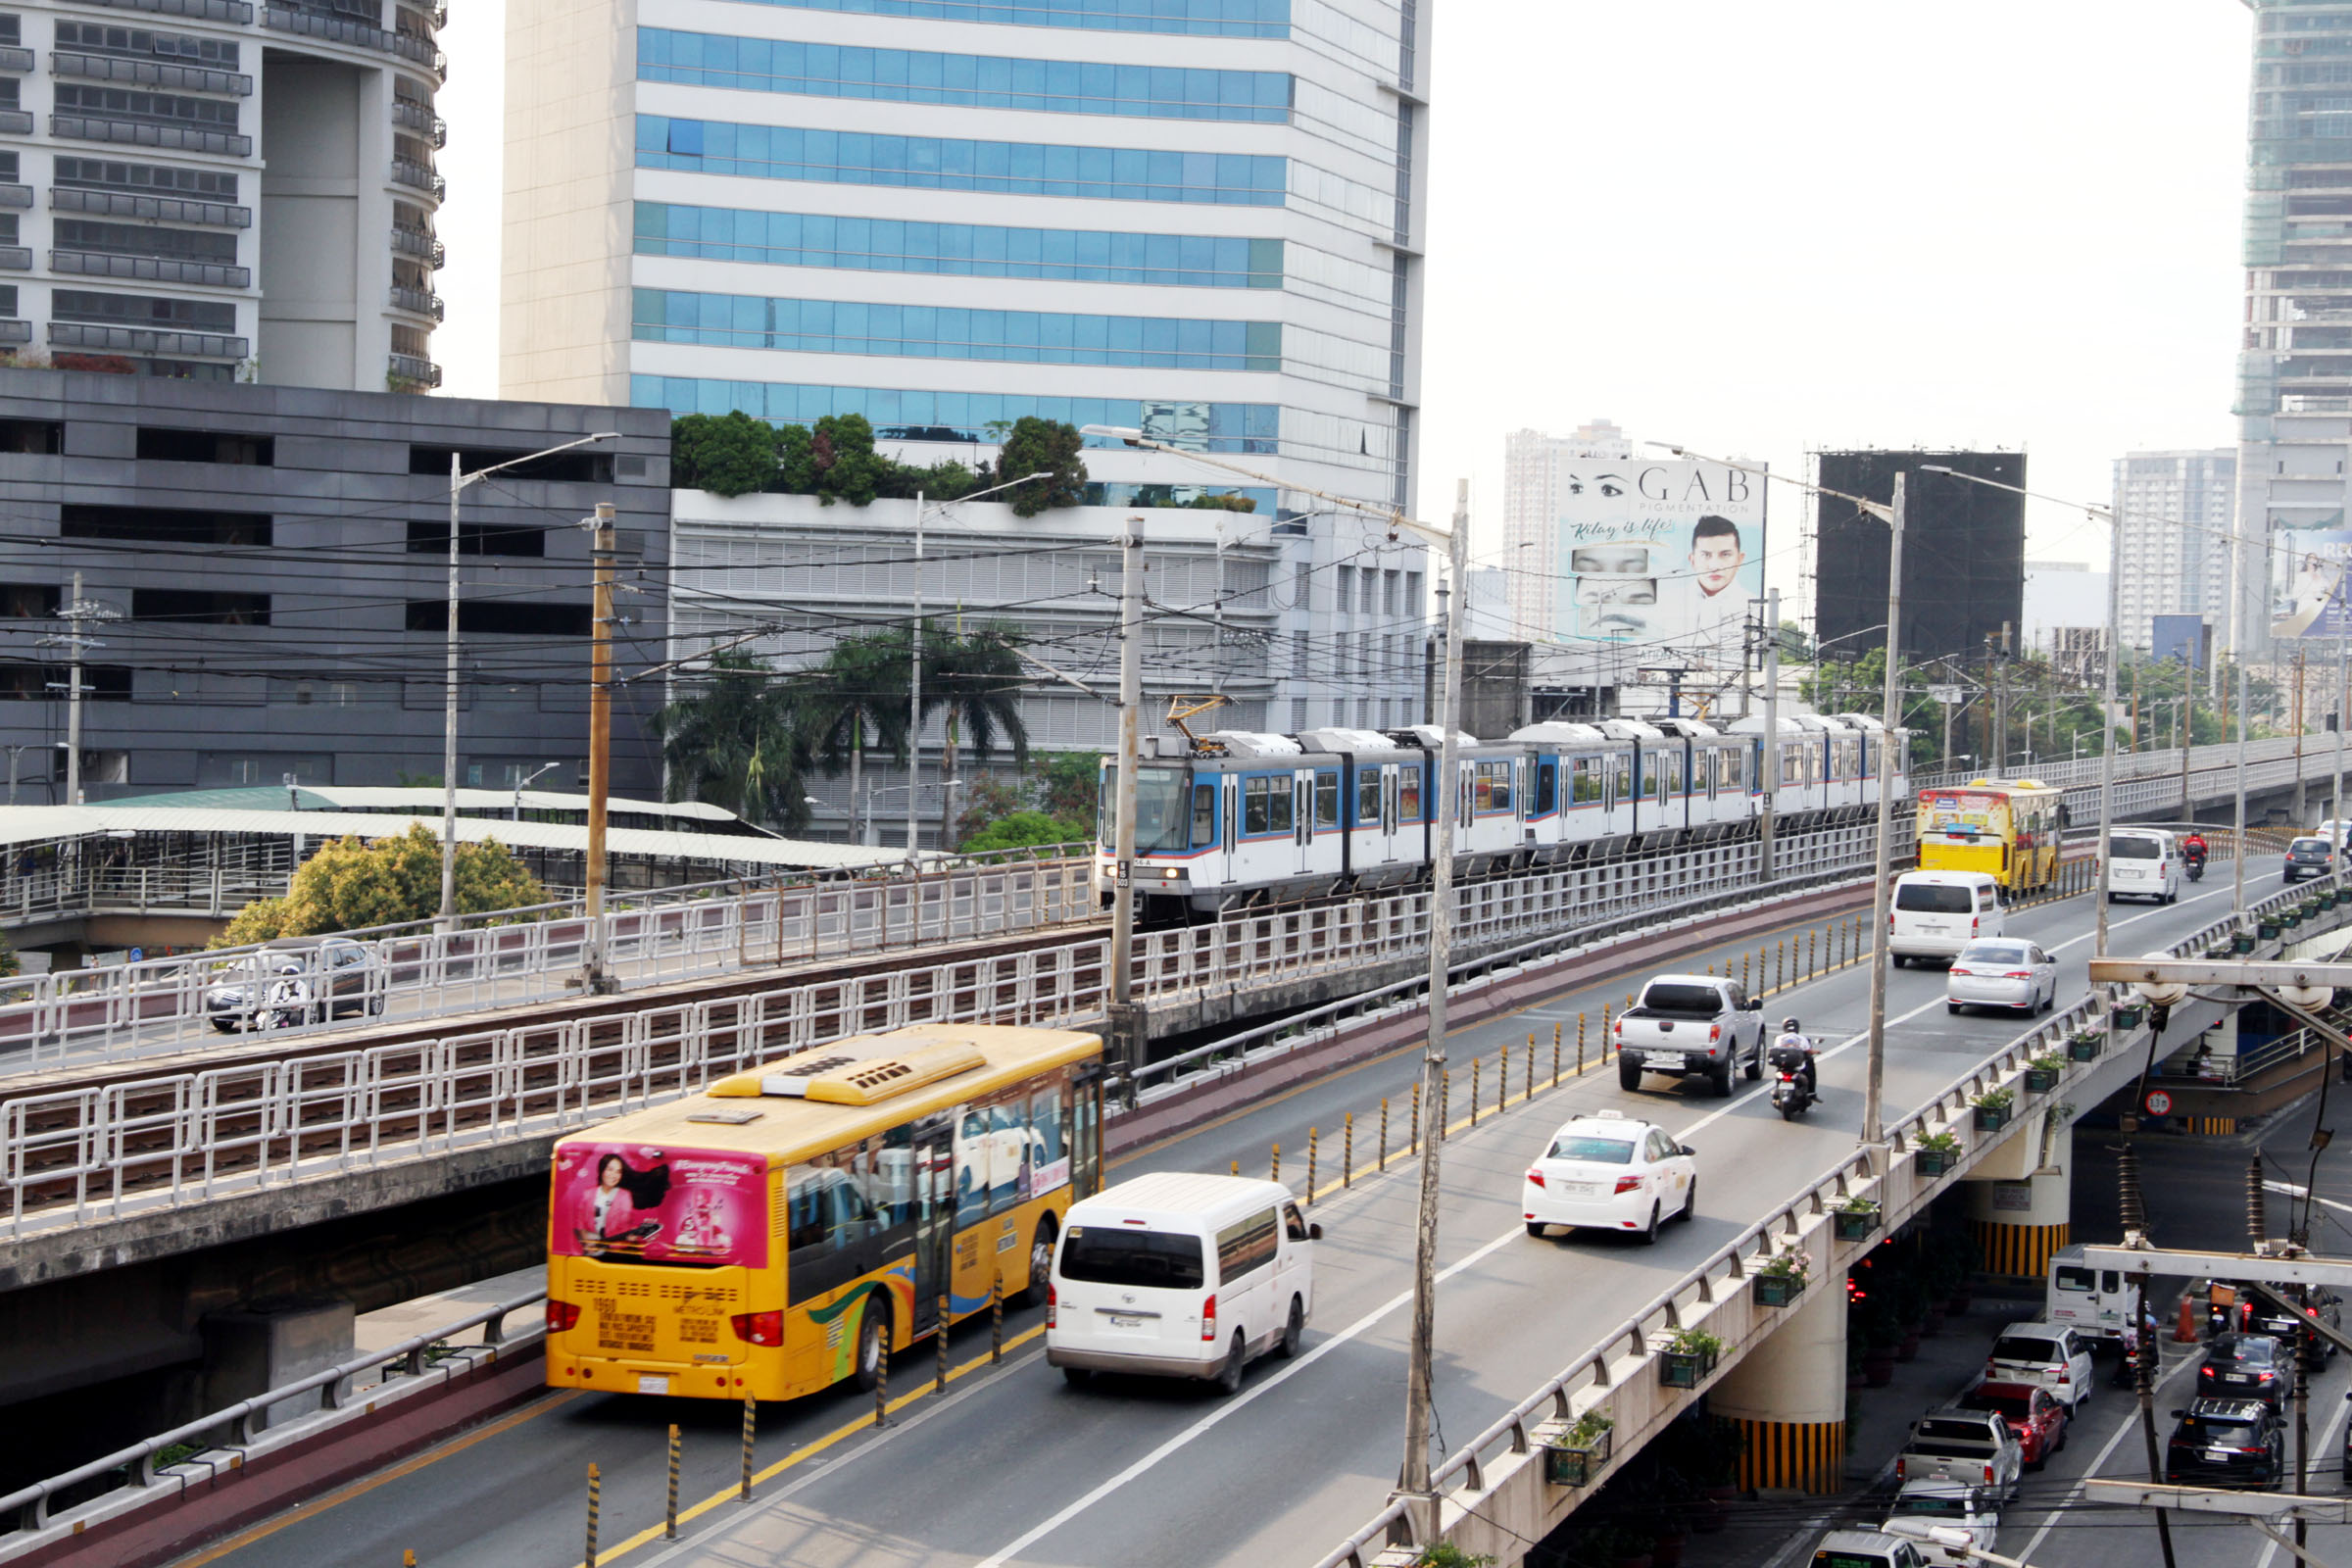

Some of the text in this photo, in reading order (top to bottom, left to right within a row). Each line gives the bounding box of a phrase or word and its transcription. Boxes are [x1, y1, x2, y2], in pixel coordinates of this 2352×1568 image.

[1639, 466, 1749, 502] GAB
[1639, 503, 1749, 514] PIGMENTATION
[1570, 518, 1671, 541] Kilay is life
